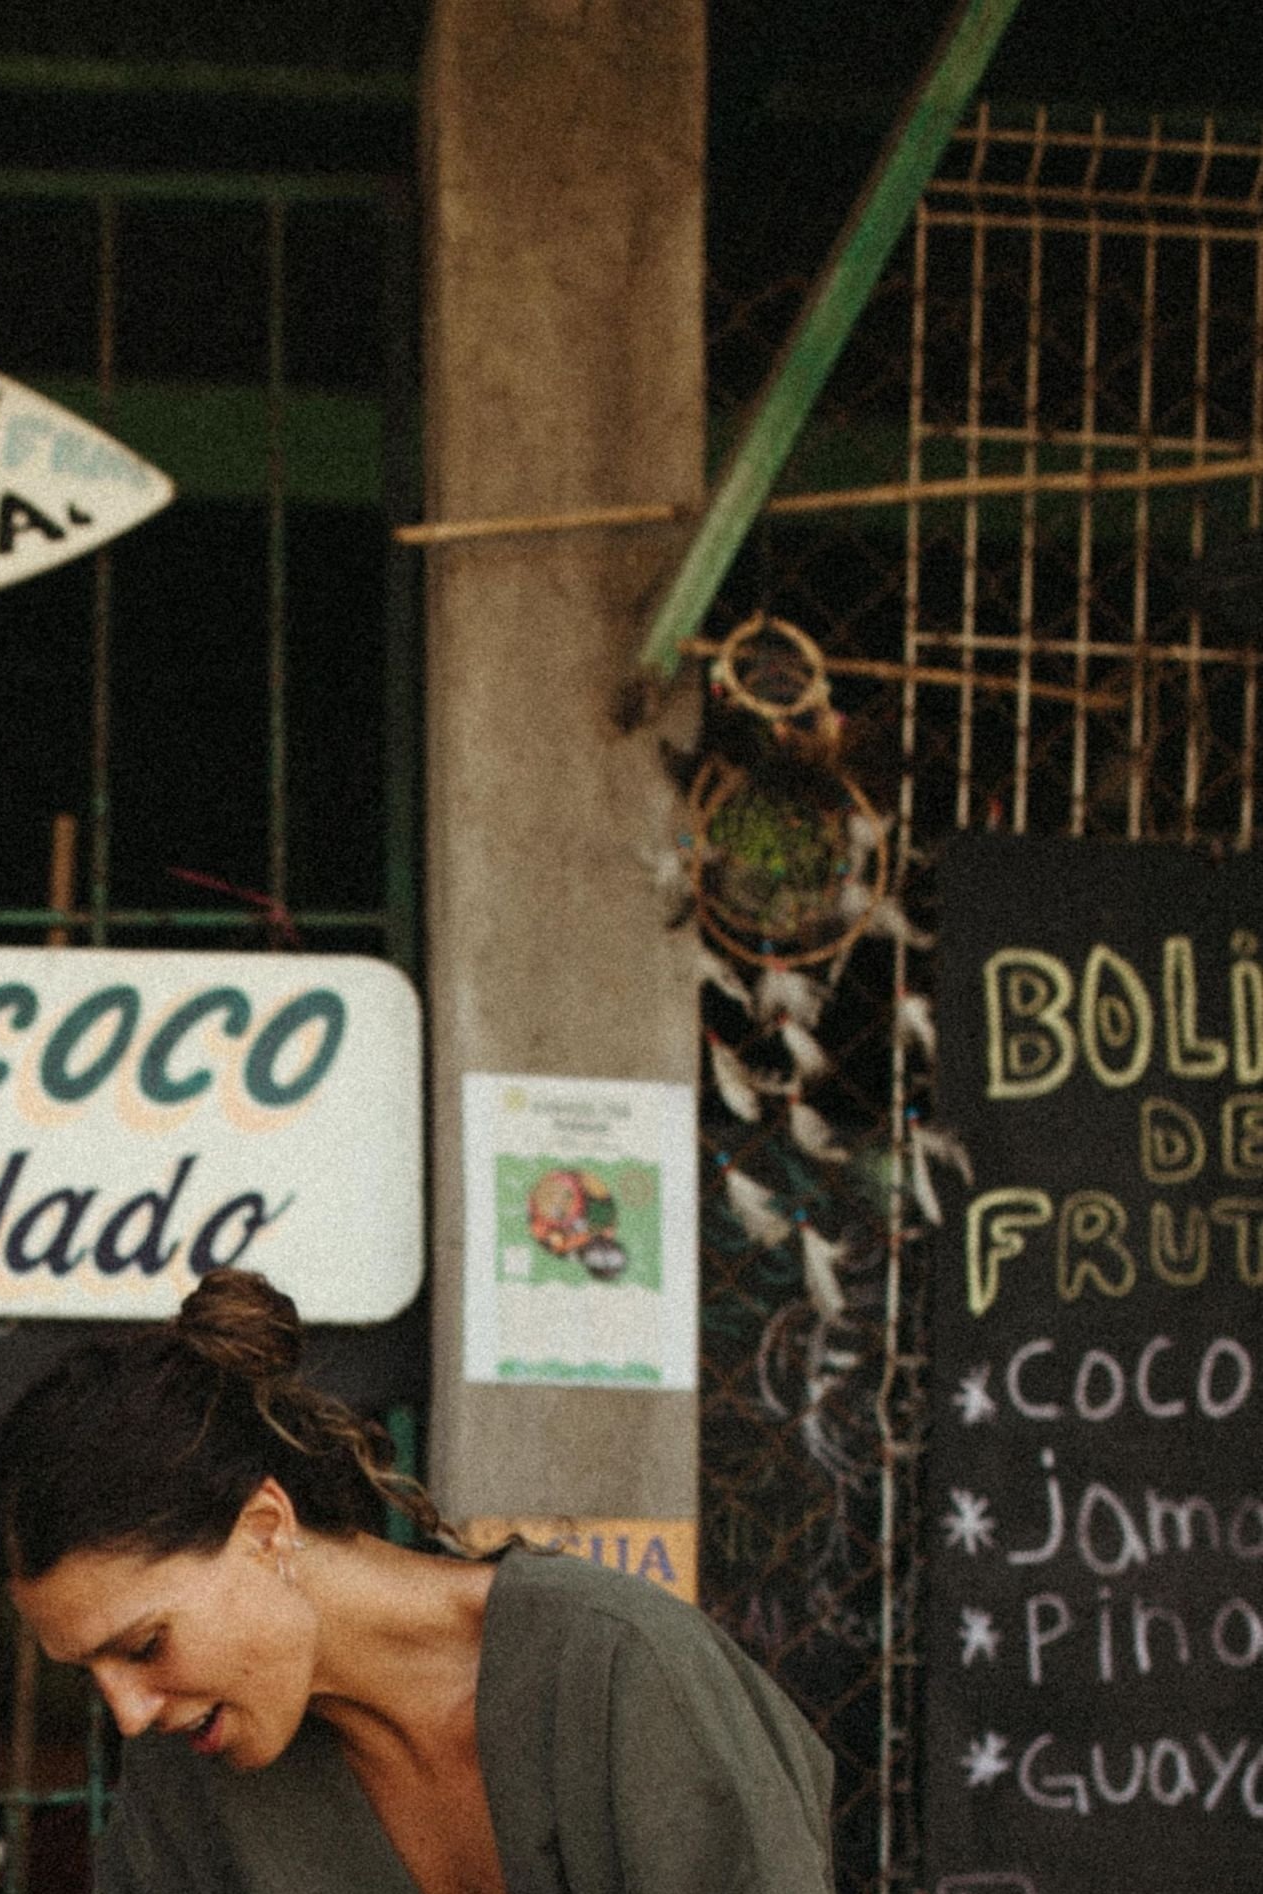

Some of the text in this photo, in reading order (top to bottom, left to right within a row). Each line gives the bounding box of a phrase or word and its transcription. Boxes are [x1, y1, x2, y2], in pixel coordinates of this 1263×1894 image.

[1142, 1094, 1263, 1186] DE
[966, 1186, 1263, 1318] FRUT
[1005, 1338, 1255, 1422] COCO
[549, 1534, 676, 1582] UA
